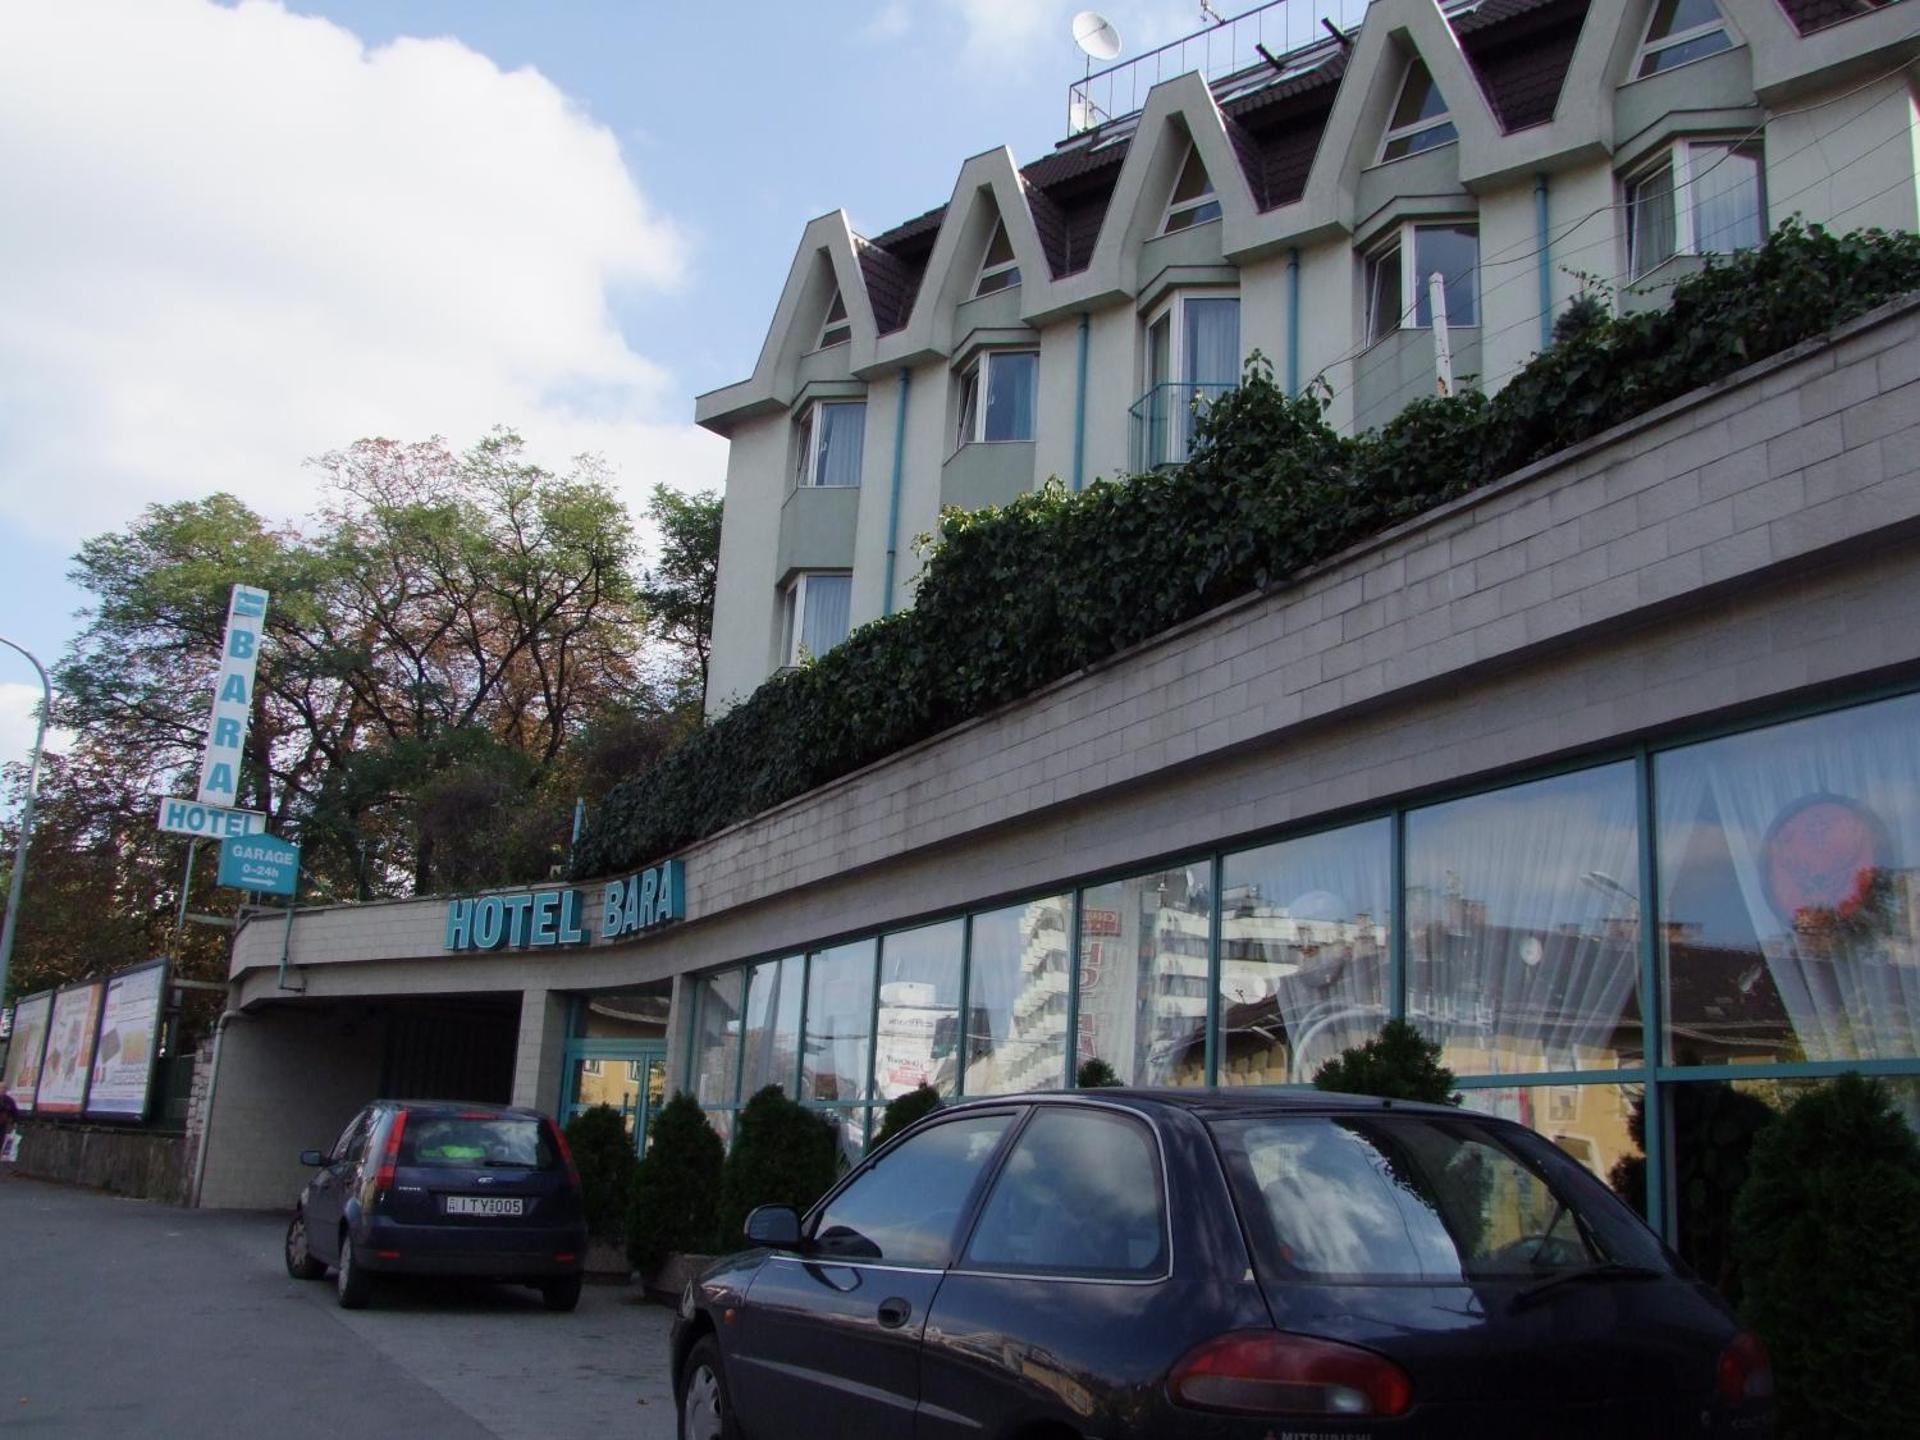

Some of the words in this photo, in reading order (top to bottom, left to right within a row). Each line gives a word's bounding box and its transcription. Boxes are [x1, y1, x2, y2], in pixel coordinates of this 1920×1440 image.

[205, 628, 255, 795] BARA
[167, 801, 251, 838] HOTEL
[232, 844, 294, 866] GARAGE
[444, 888, 585, 950] HOTEL
[600, 859, 678, 938] BARA
